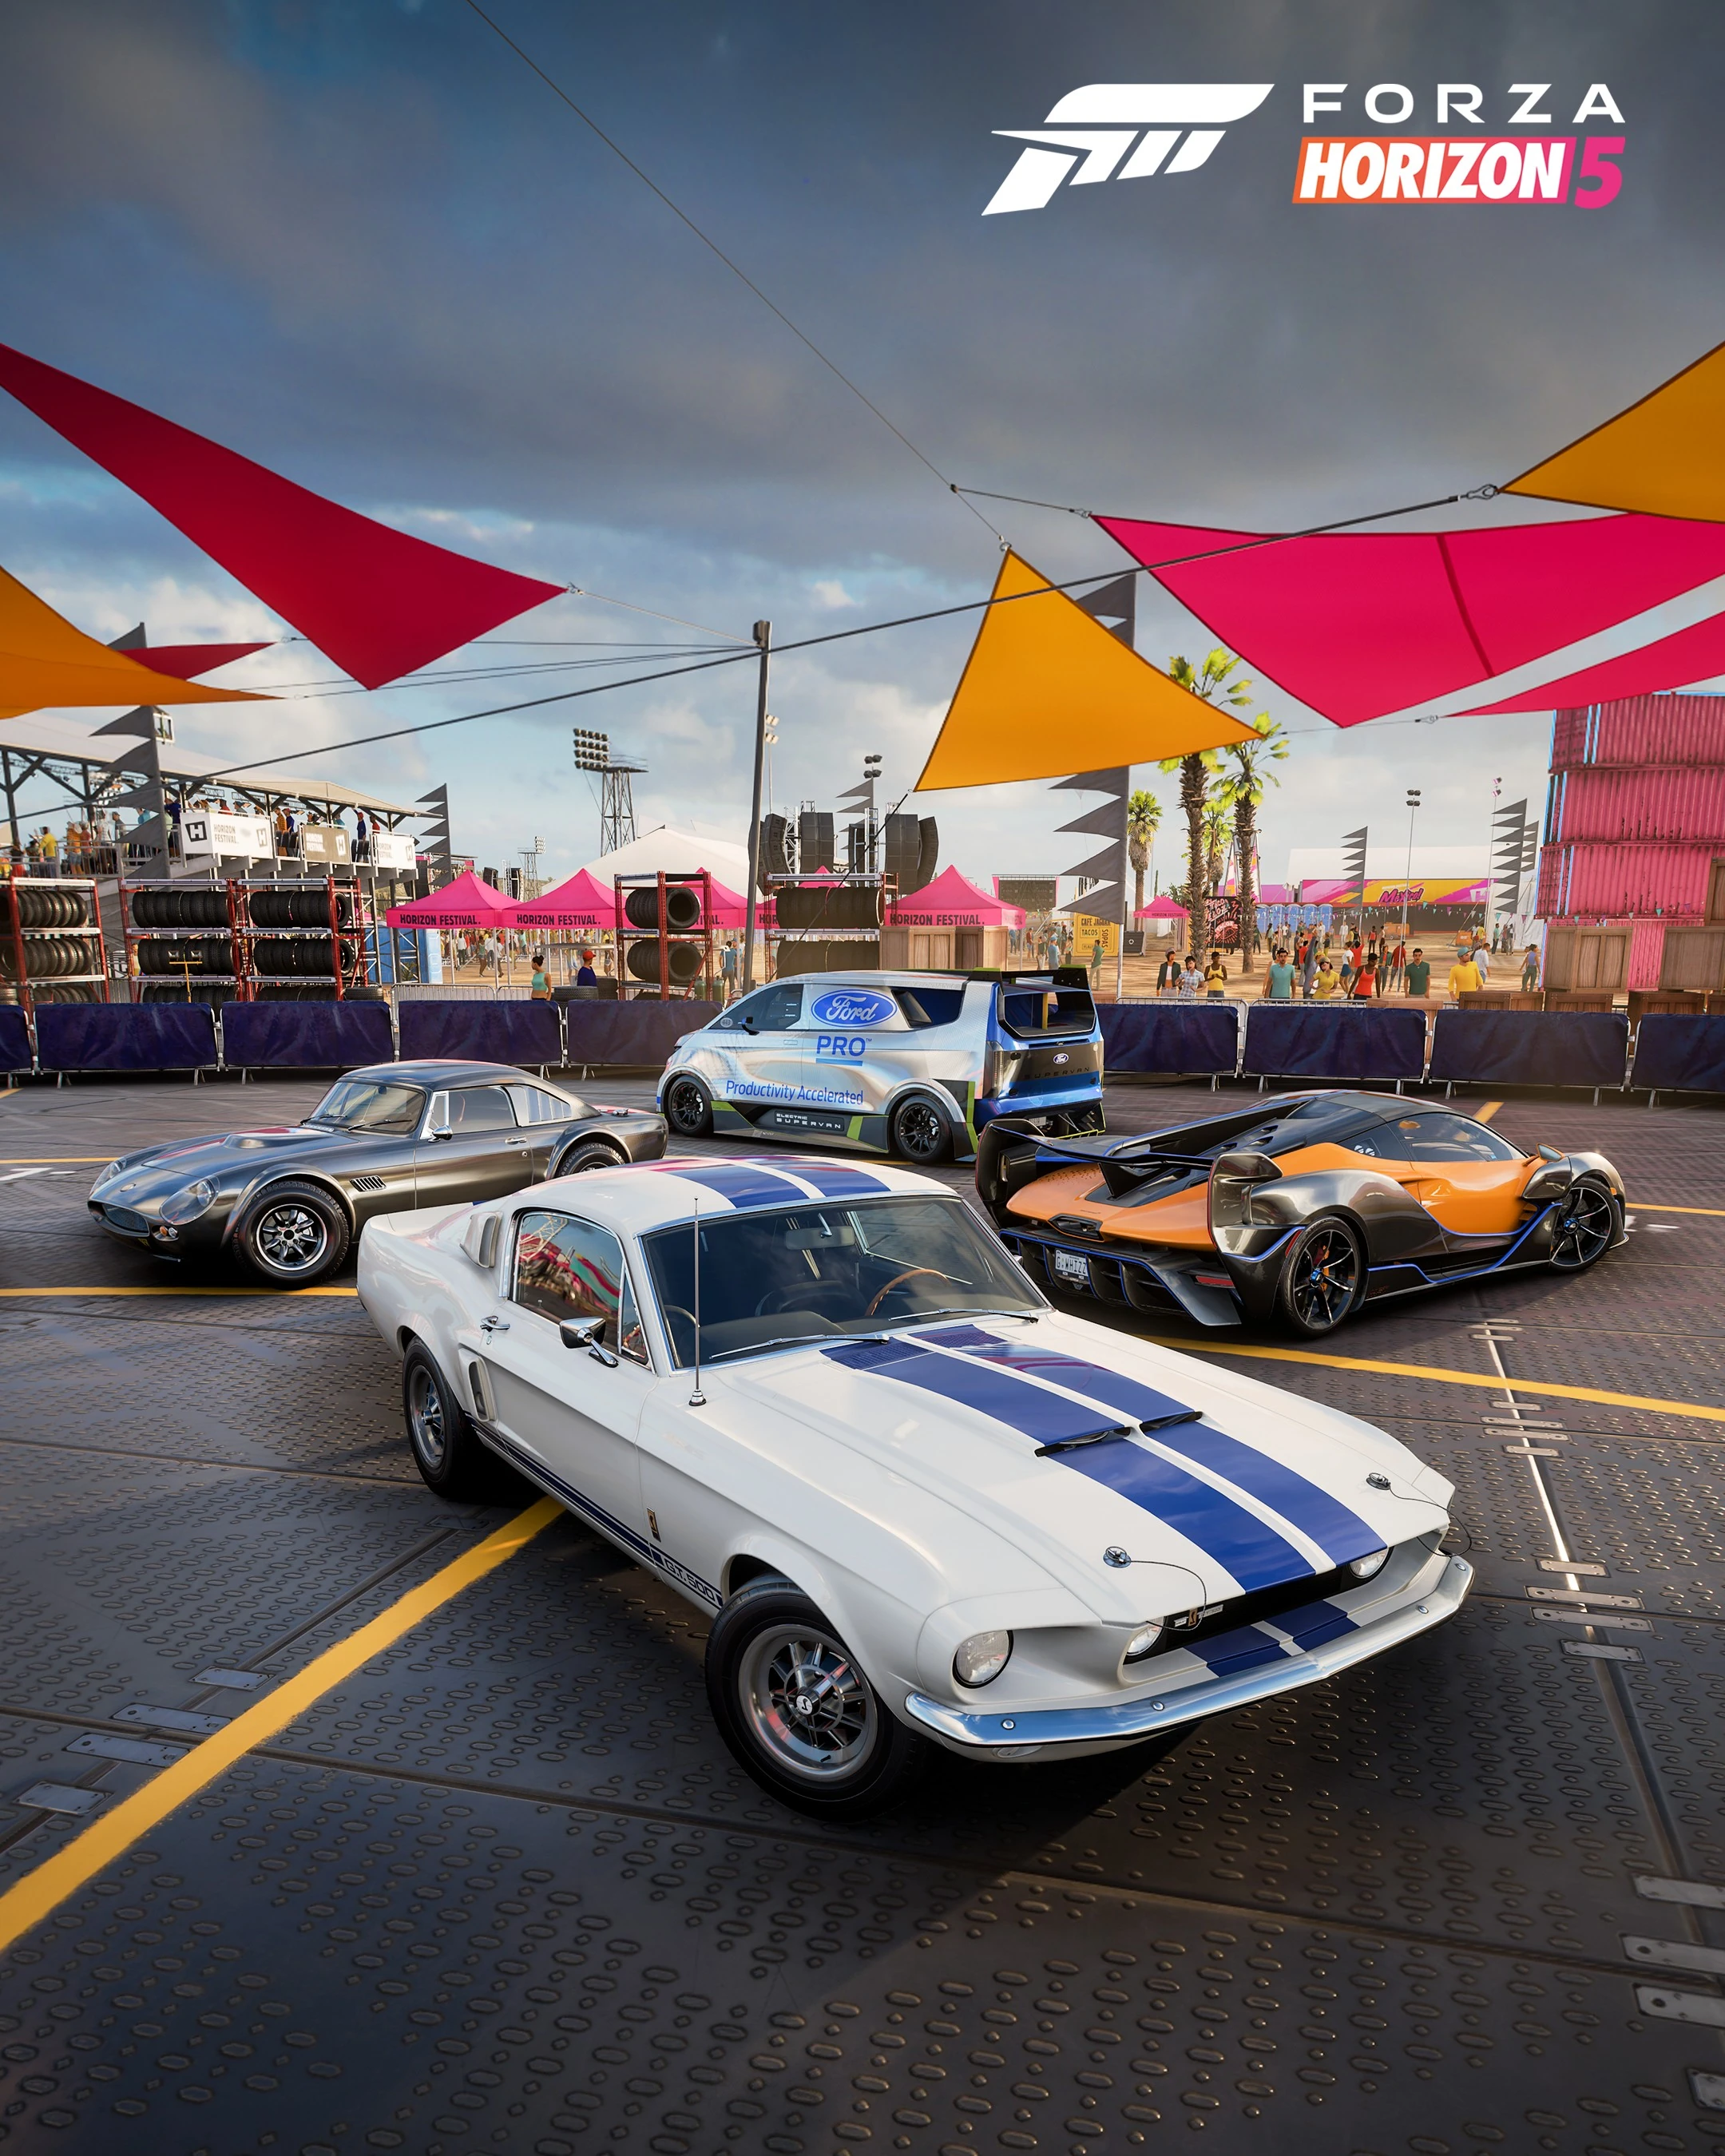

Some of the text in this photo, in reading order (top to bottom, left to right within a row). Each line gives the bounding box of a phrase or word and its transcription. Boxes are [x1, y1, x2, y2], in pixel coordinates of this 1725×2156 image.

[213, 824, 236, 834] HORIZON
[400, 914, 437, 925] HORIZON
[517, 914, 555, 925] HORIZON
[890, 914, 933, 925] HORIZON
[825, 994, 879, 1021] Ford
[726, 1080, 863, 1105] Productivity Accelerated
[776, 1117, 841, 1129] SUPERVAN
